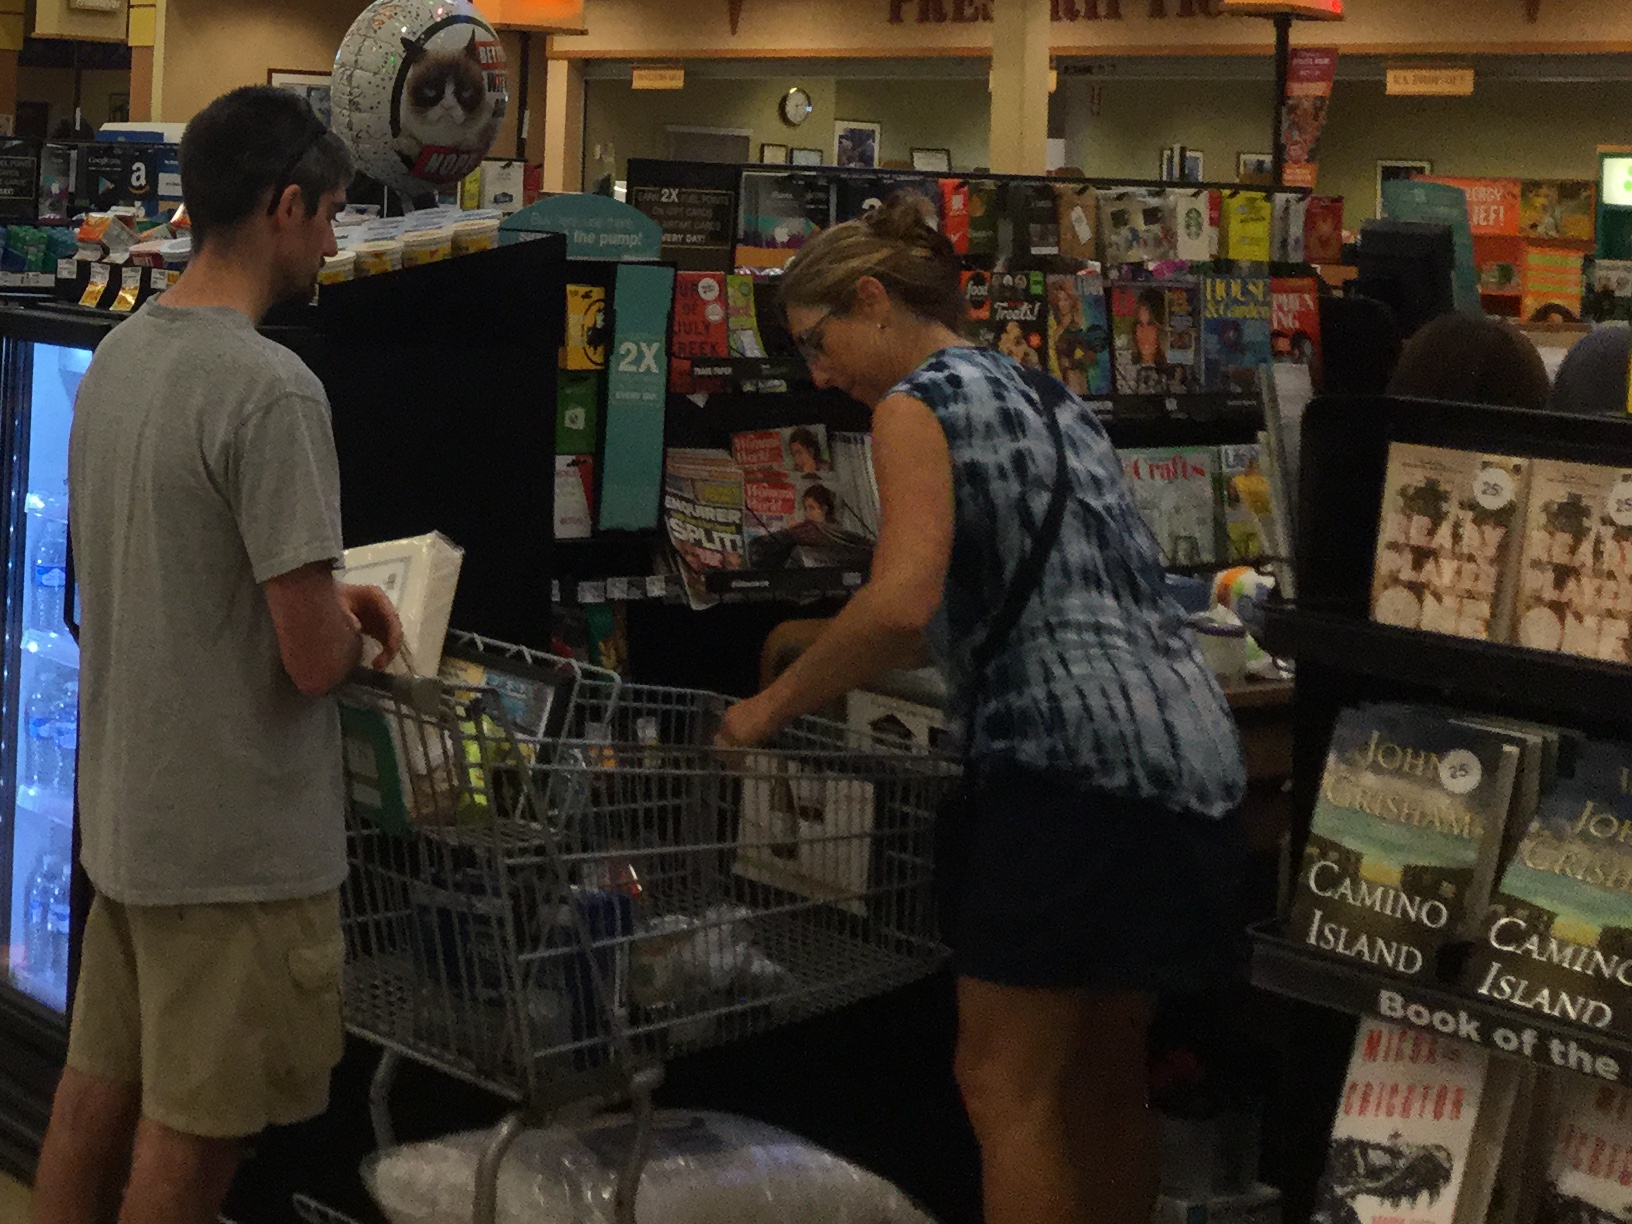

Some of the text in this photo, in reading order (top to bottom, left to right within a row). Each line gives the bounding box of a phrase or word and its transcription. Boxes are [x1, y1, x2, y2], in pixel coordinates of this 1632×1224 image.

[130, 161, 147, 188] a
[660, 187, 680, 204] 2X
[573, 231, 643, 248] the pump!
[966, 280, 989, 300] food
[994, 301, 1042, 322] Treats!
[618, 341, 661, 374] 2X
[674, 342, 720, 357] REEK
[1131, 453, 1206, 481] Crafts
[664, 493, 743, 525] ENQUIRER
[669, 518, 743, 555] SPLIT!
[1322, 779, 1482, 839] GRISHAM
[1307, 859, 1449, 929] CAMINO
[1305, 908, 1424, 975] ISLAND
[1476, 960, 1614, 1029] ISLAND
[1377, 988, 1621, 1082] Book of the
